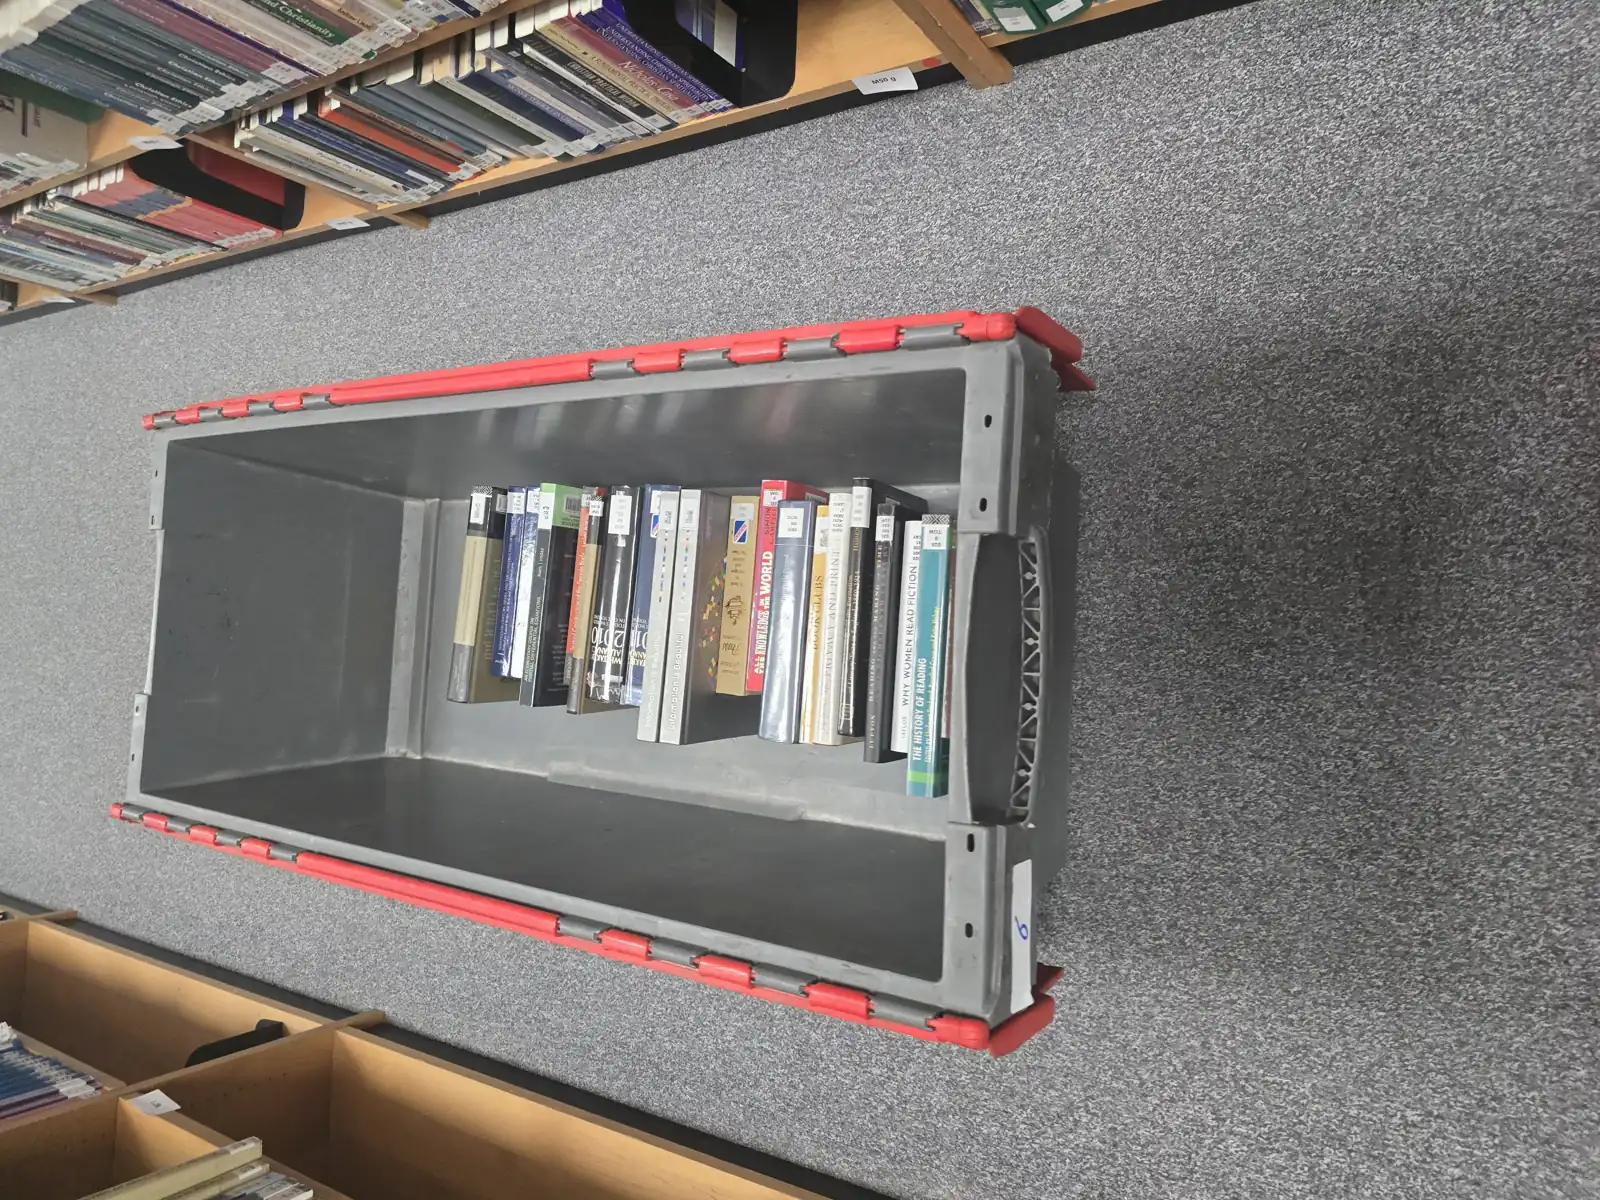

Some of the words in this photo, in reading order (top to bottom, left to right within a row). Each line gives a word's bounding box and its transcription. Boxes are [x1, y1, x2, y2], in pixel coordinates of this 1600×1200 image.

[279, 5, 335, 38] Christianity
[597, 27, 643, 63] UNDERSTANDING
[641, 59, 669, 82] CHRISTIAN
[669, 78, 700, 102] SPIRITUALITY
[606, 26, 653, 61] UNDERSTANDING
[651, 58, 680, 81] CHRISTIAN
[678, 77, 710, 101] SPIRITUALITY
[616, 22, 661, 56] UNDERSTANDING
[660, 51, 688, 75] CHRISTIAN
[686, 71, 718, 98] SPIRITUALITY
[618, 60, 657, 87] Nicholas
[135, 82, 170, 99] Christian
[871, 77, 889, 85] M50
[760, 551, 772, 595] WORLD
[907, 566, 917, 605] FICTION
[814, 575, 822, 612] CLUBS
[827, 592, 837, 619] AND
[533, 596, 542, 626] EQUATIONS
[905, 609, 915, 635] READ
[591, 626, 626, 648] 2010
[755, 610, 769, 654] KNOWLEDGE
[902, 639, 914, 679] WOMEN
[916, 658, 927, 694] READING
[668, 681, 679, 730] Information
[674, 632, 683, 669] Beautiful
[868, 658, 876, 702] READING
[901, 684, 910, 706] WHY
[915, 695, 924, 707] OF
[913, 710, 924, 744] HISTORY
[913, 746, 922, 761] THE
